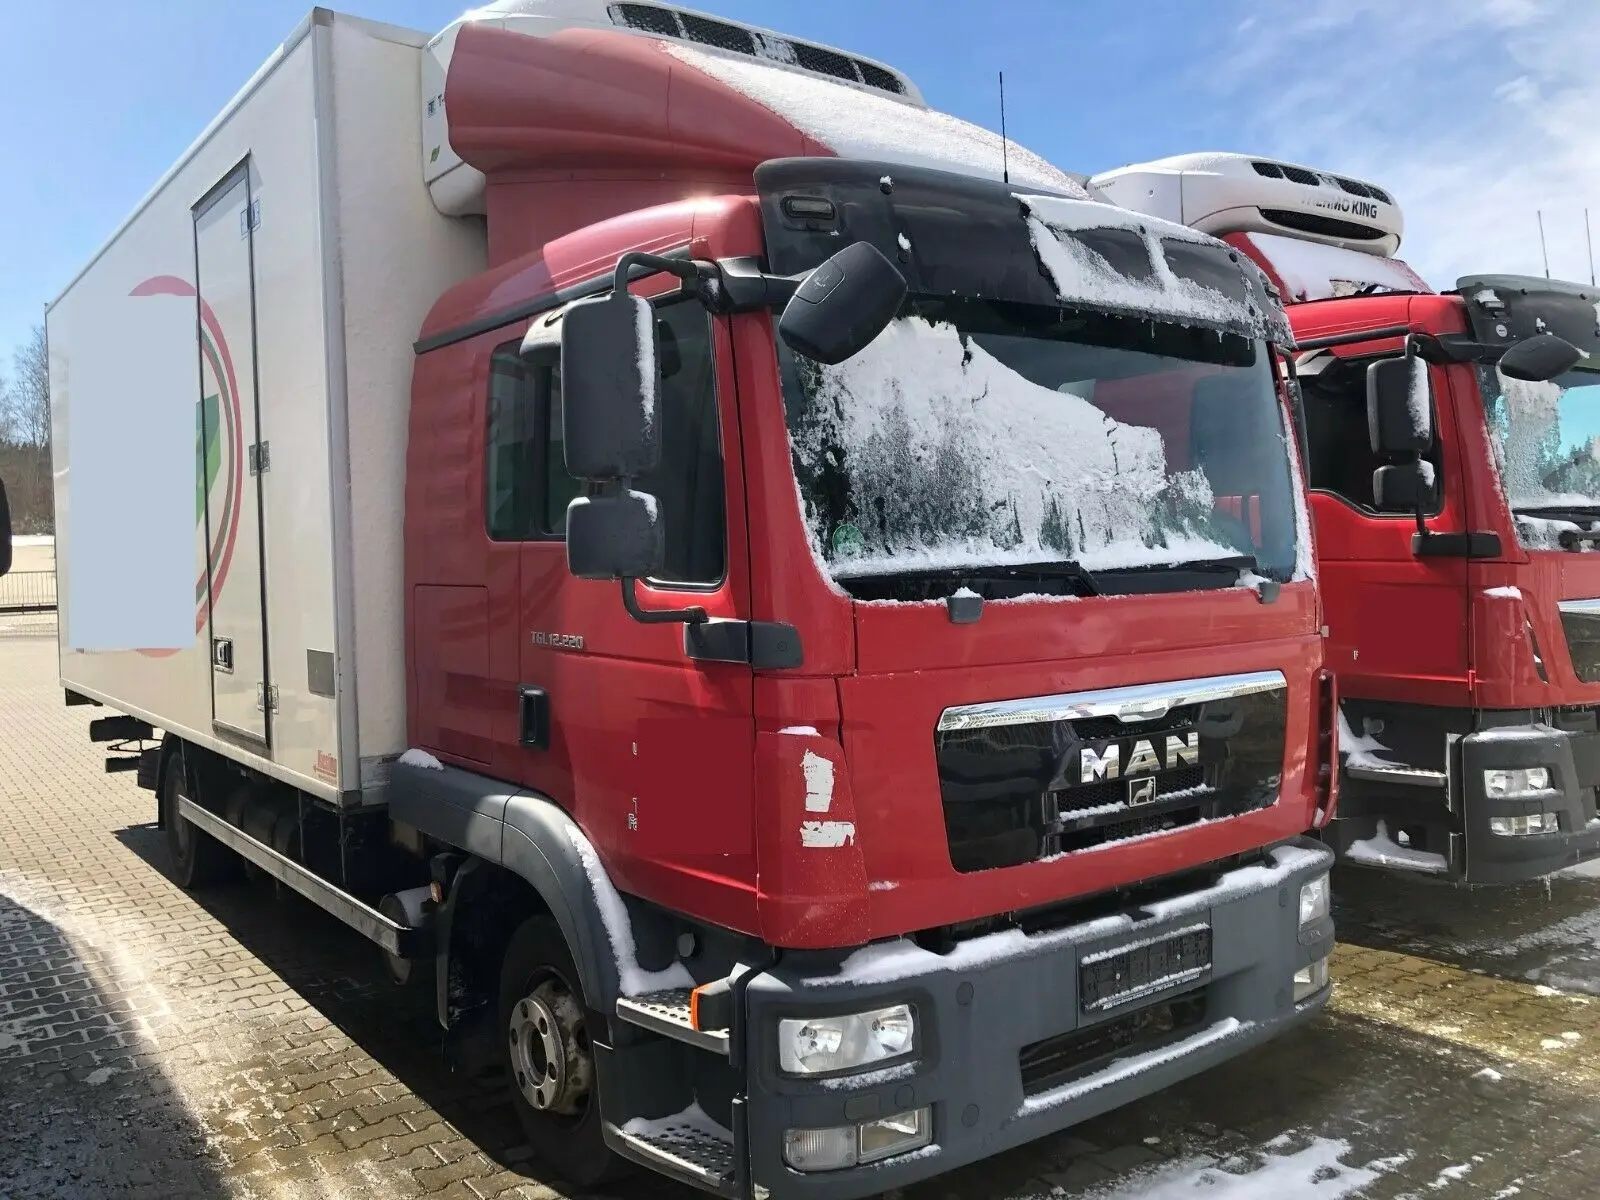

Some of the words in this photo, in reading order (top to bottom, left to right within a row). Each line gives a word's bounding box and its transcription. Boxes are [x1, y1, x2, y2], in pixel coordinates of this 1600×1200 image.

[1301, 195, 1350, 212] ERMO
[1351, 201, 1378, 219] KING
[1080, 732, 1199, 783] MAN
